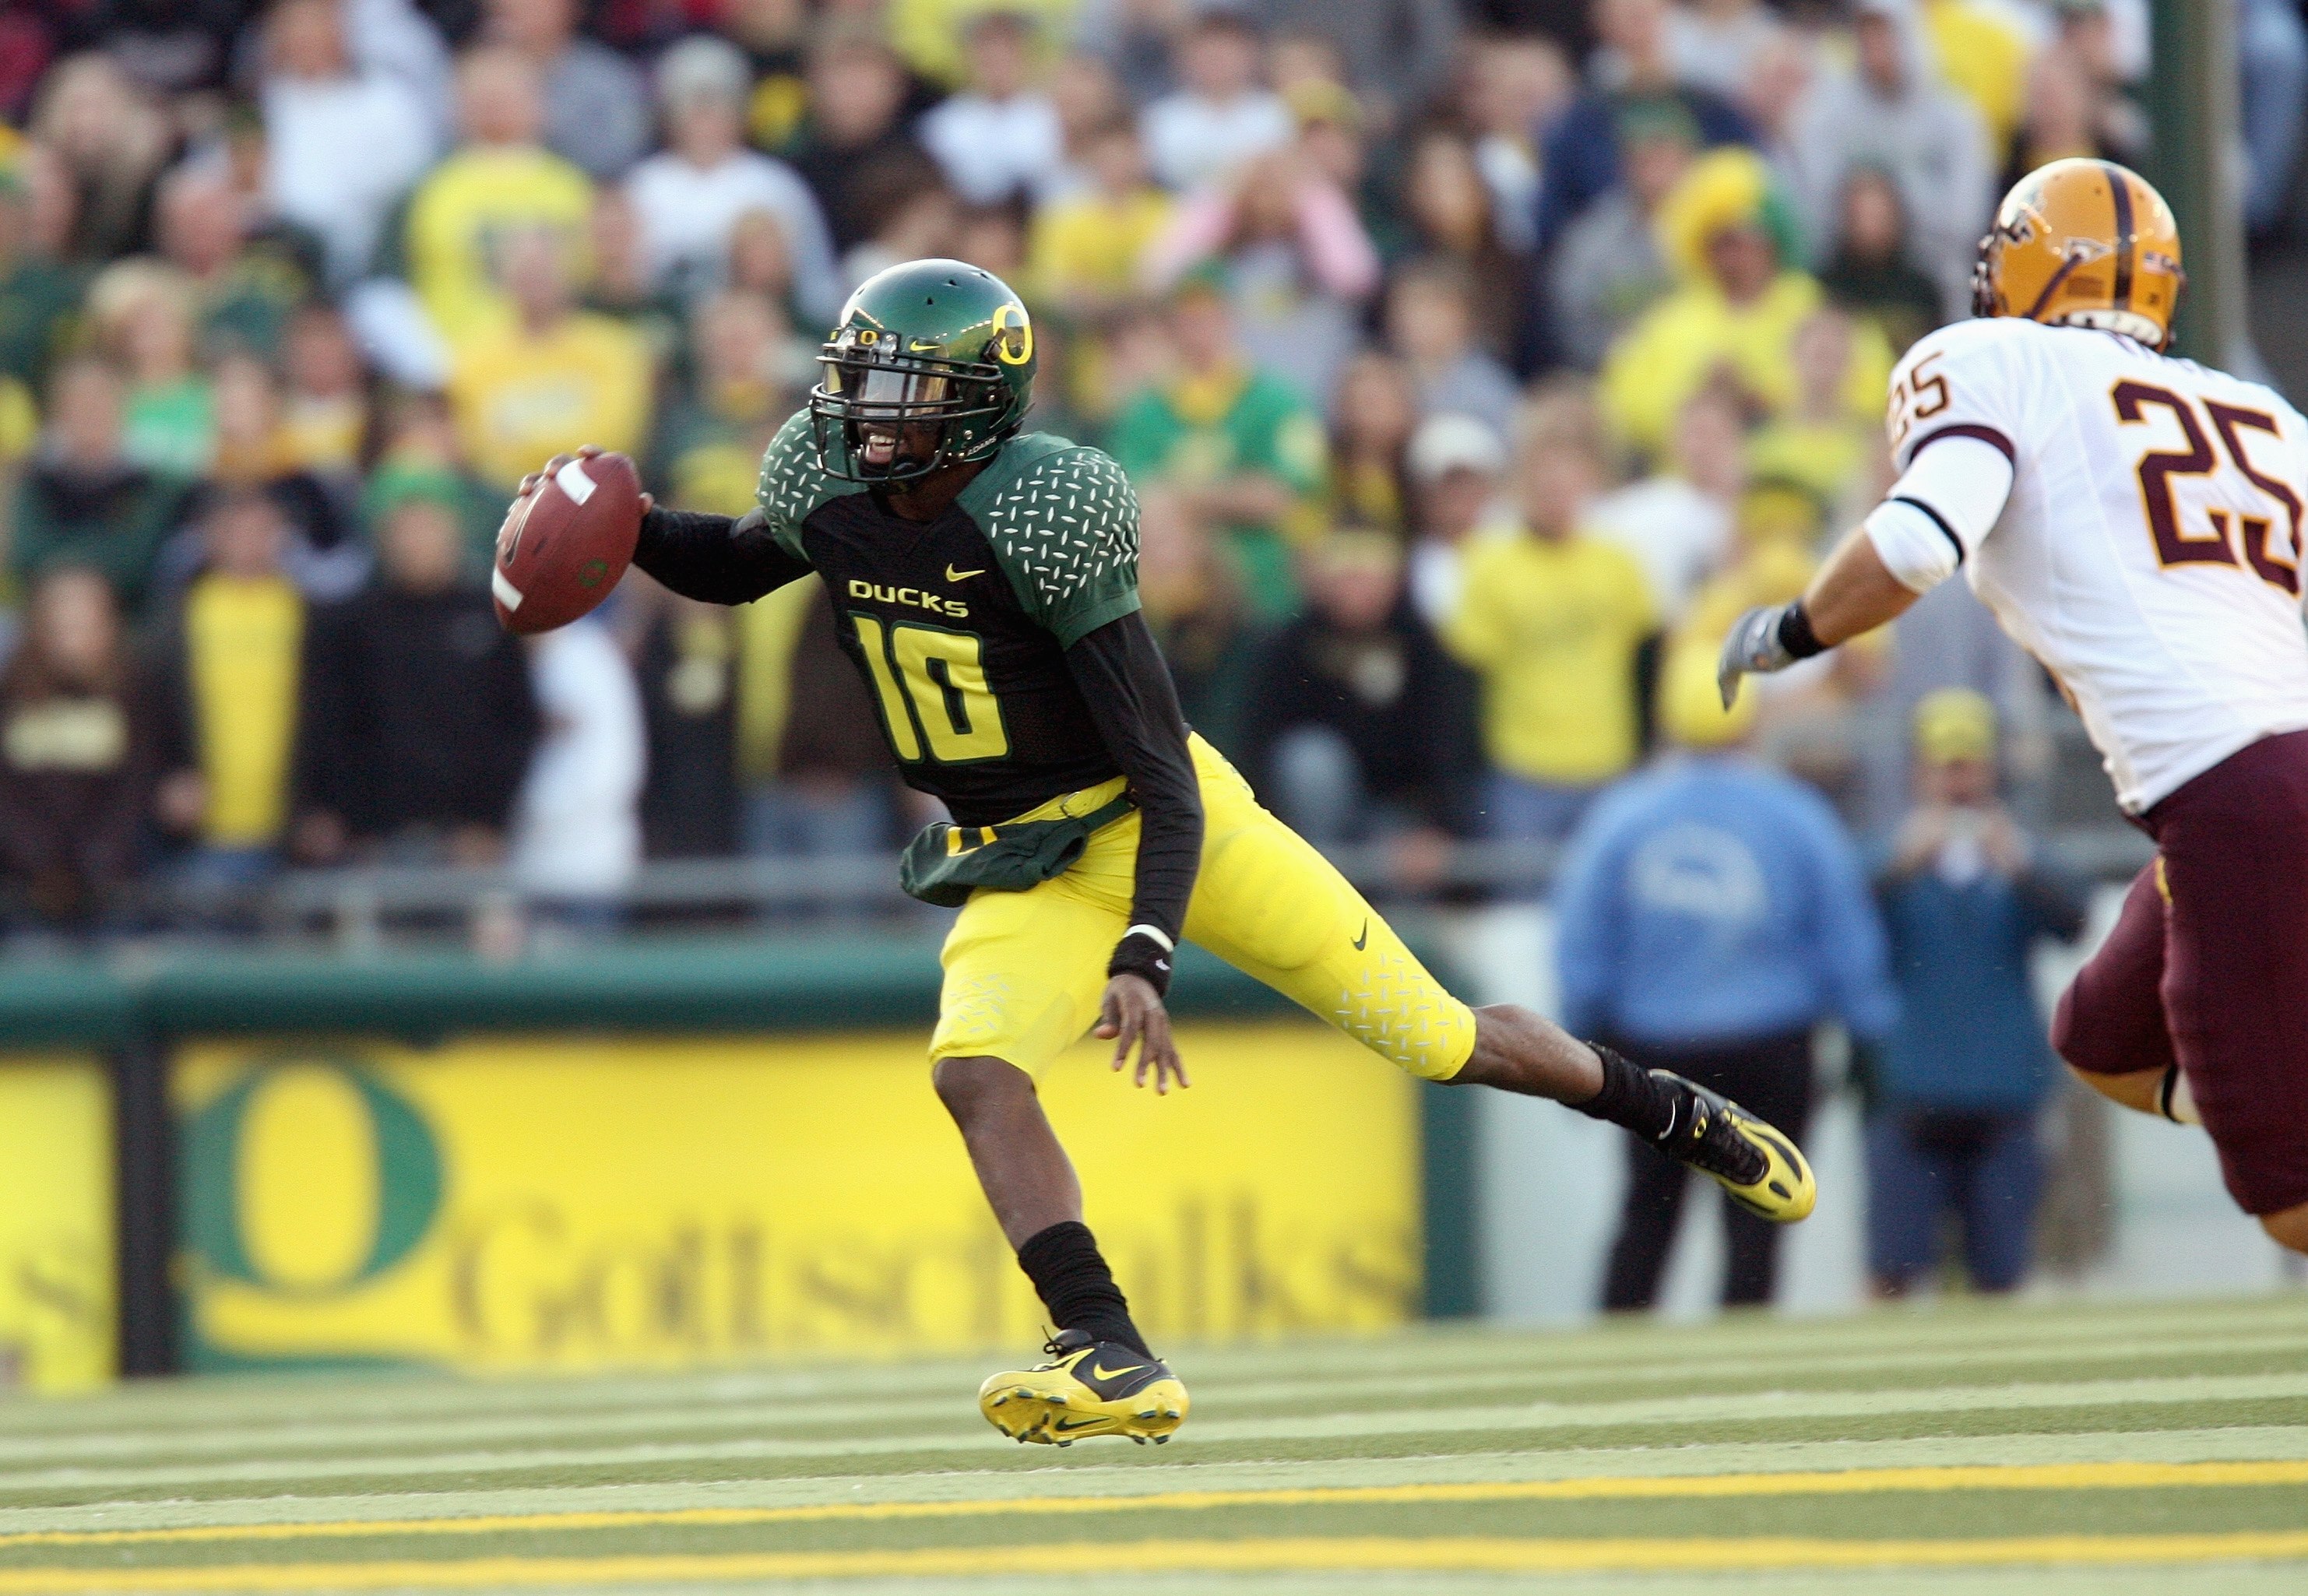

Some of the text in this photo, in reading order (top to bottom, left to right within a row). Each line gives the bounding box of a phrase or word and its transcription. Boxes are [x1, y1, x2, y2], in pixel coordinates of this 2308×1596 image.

[2109, 377, 2303, 599] 25
[849, 579, 969, 617] DUCKS
[848, 610, 1013, 765] 10
